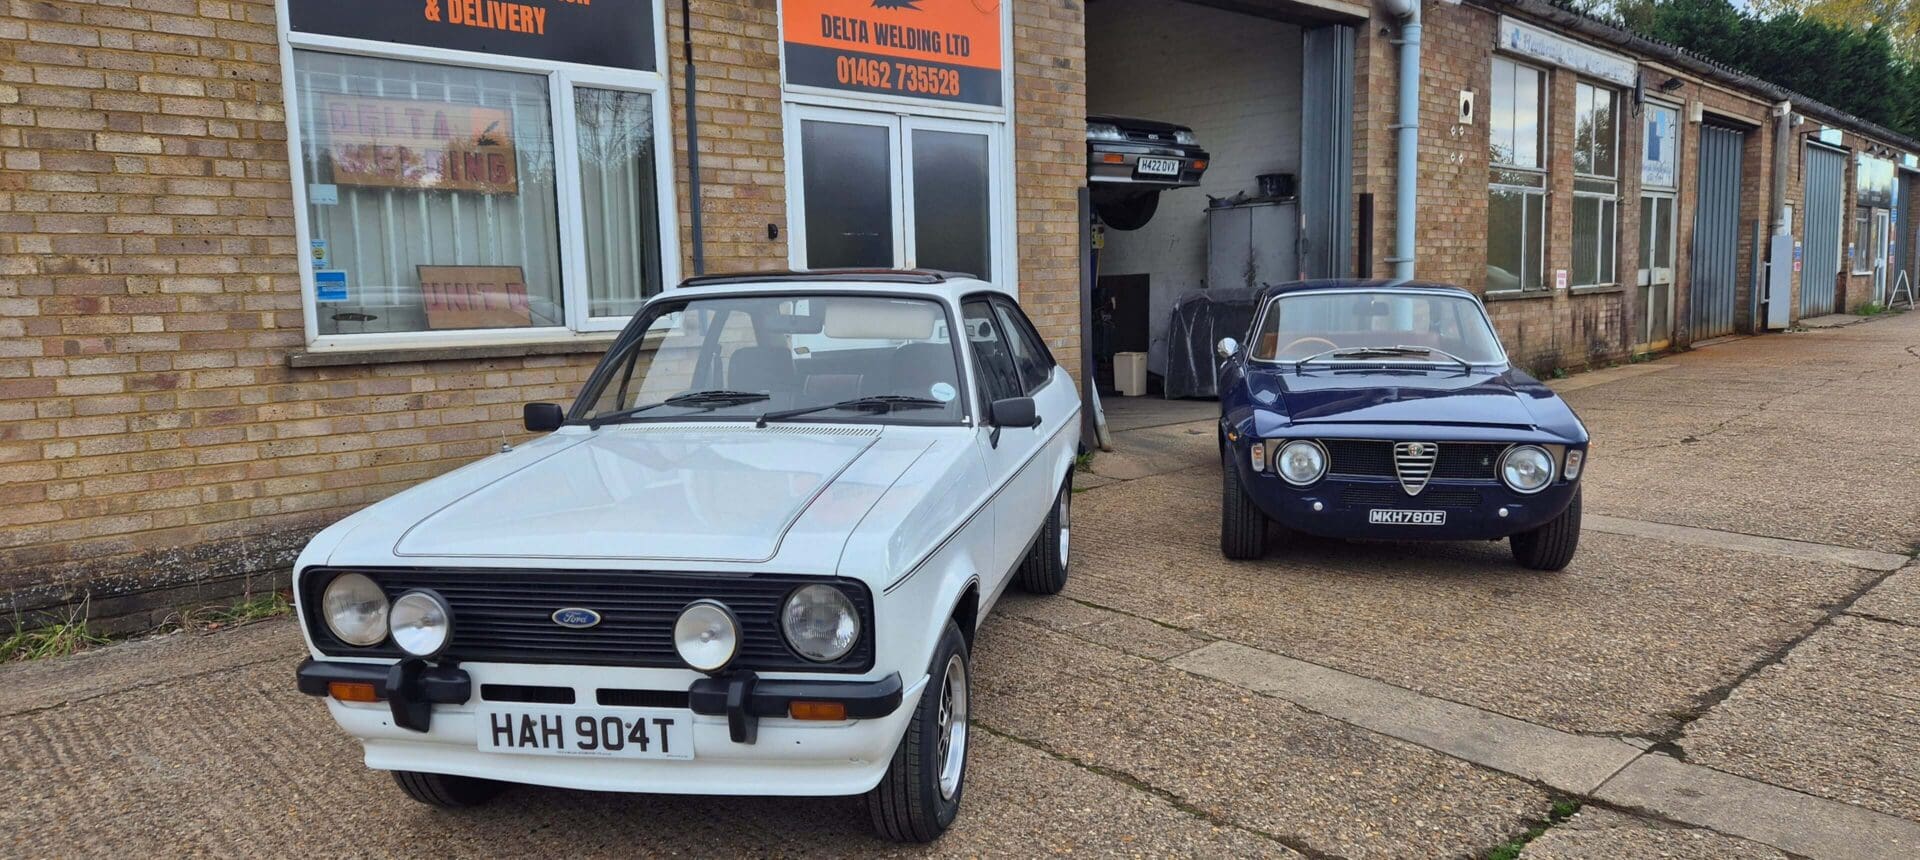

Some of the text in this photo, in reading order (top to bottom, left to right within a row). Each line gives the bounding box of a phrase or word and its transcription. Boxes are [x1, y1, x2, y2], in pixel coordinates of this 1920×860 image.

[425, 0, 545, 35] & DELIVERY
[821, 14, 970, 57] DELTA WELDING LTD
[837, 56, 960, 96] 01462 735528
[329, 102, 451, 140] DELTA
[1141, 159, 1161, 171] H422
[420, 282, 498, 312] UNIT
[1372, 511, 1443, 523] MKH780E
[563, 611, 588, 623] Ford
[490, 712, 675, 753] HAH 904T
